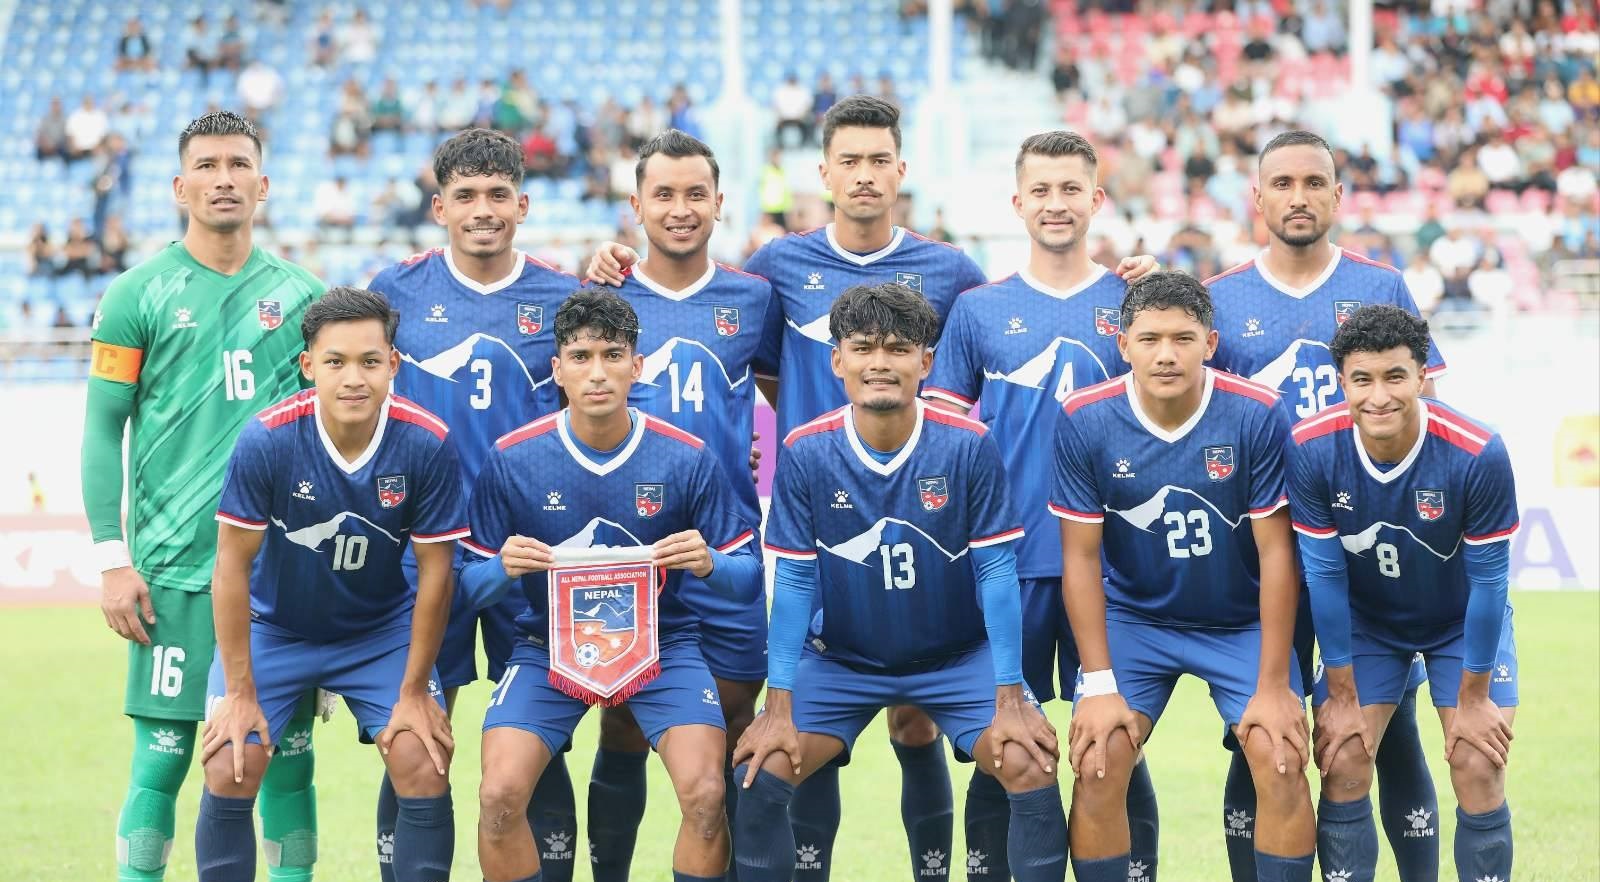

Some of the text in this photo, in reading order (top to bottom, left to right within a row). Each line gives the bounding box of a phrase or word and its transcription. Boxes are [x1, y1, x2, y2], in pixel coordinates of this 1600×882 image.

[95, 347, 118, 375] C
[223, 349, 256, 401] 16
[469, 358, 492, 410] 3
[668, 361, 705, 413] 14
[1054, 361, 1074, 403] 4
[1292, 364, 1338, 419] 32
[292, 492, 316, 501] KELME
[1331, 502, 1354, 511] KELME
[1164, 509, 1213, 559] 23
[332, 534, 369, 571] 10
[880, 542, 916, 590] 13
[1375, 542, 1401, 579] 8
[561, 571, 647, 584] ALL NEPAL FOOTBALL ASSOCIATION
[584, 589, 622, 601] NEPAL
[150, 644, 186, 697] 16
[148, 743, 185, 756] KELME
[282, 743, 313, 757] KELME
[1403, 827, 1436, 838] KELME
[542, 850, 573, 860] KELME
[795, 861, 822, 870] KELME
[920, 867, 947, 876] KELME
